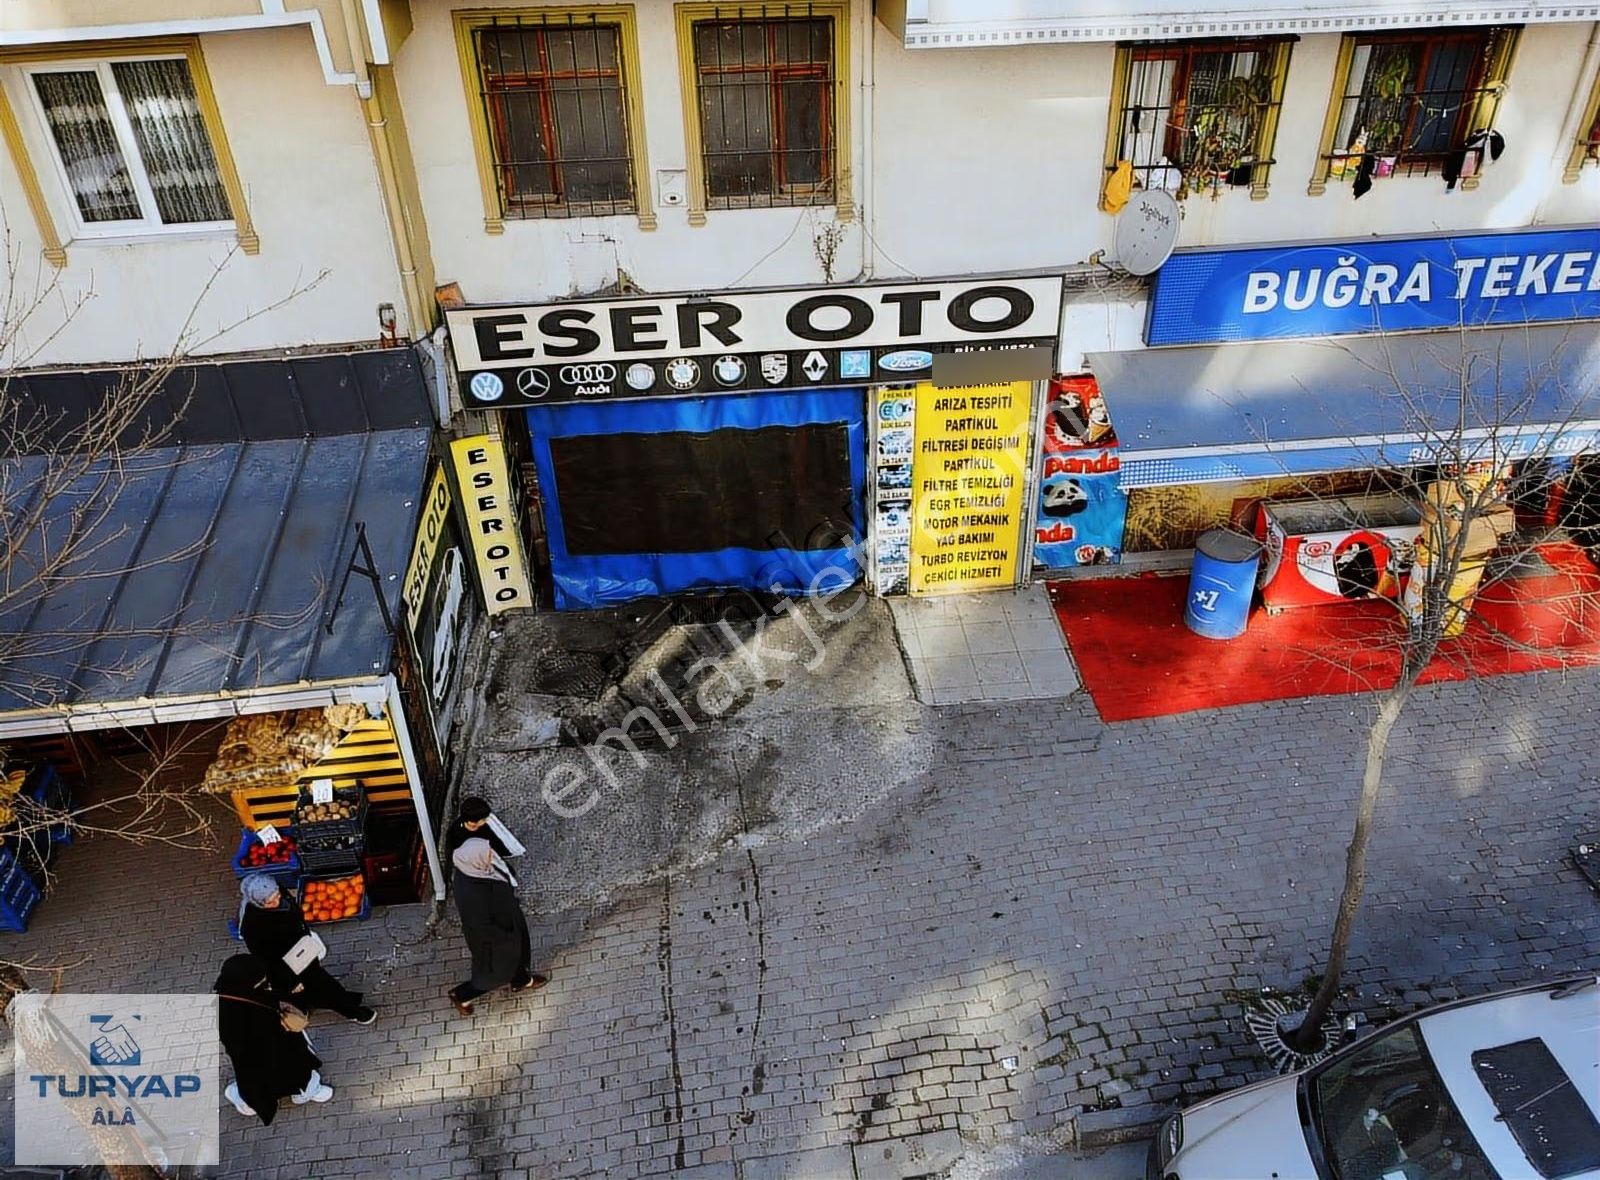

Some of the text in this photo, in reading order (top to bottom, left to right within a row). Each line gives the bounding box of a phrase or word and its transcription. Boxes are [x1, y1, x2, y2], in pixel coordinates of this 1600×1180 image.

[1243, 257, 1431, 314] BUĞRA
[472, 286, 1035, 361] ESER OTO
[574, 384, 610, 396] Audi
[934, 393, 1012, 411] ARIZA TESPİTİ
[922, 436, 968, 453] FİLTRESİ
[1044, 451, 1120, 479] panda
[923, 477, 958, 492] FİLTRE
[930, 499, 951, 511] EGR
[924, 512, 1009, 530] MOTOR MEKANİK
[958, 531, 994, 545] BAKIMI
[409, 482, 447, 616] ESER OTO
[921, 548, 1008, 567] TURBO REVİZYON
[960, 565, 1001, 580] HİZMETİ
